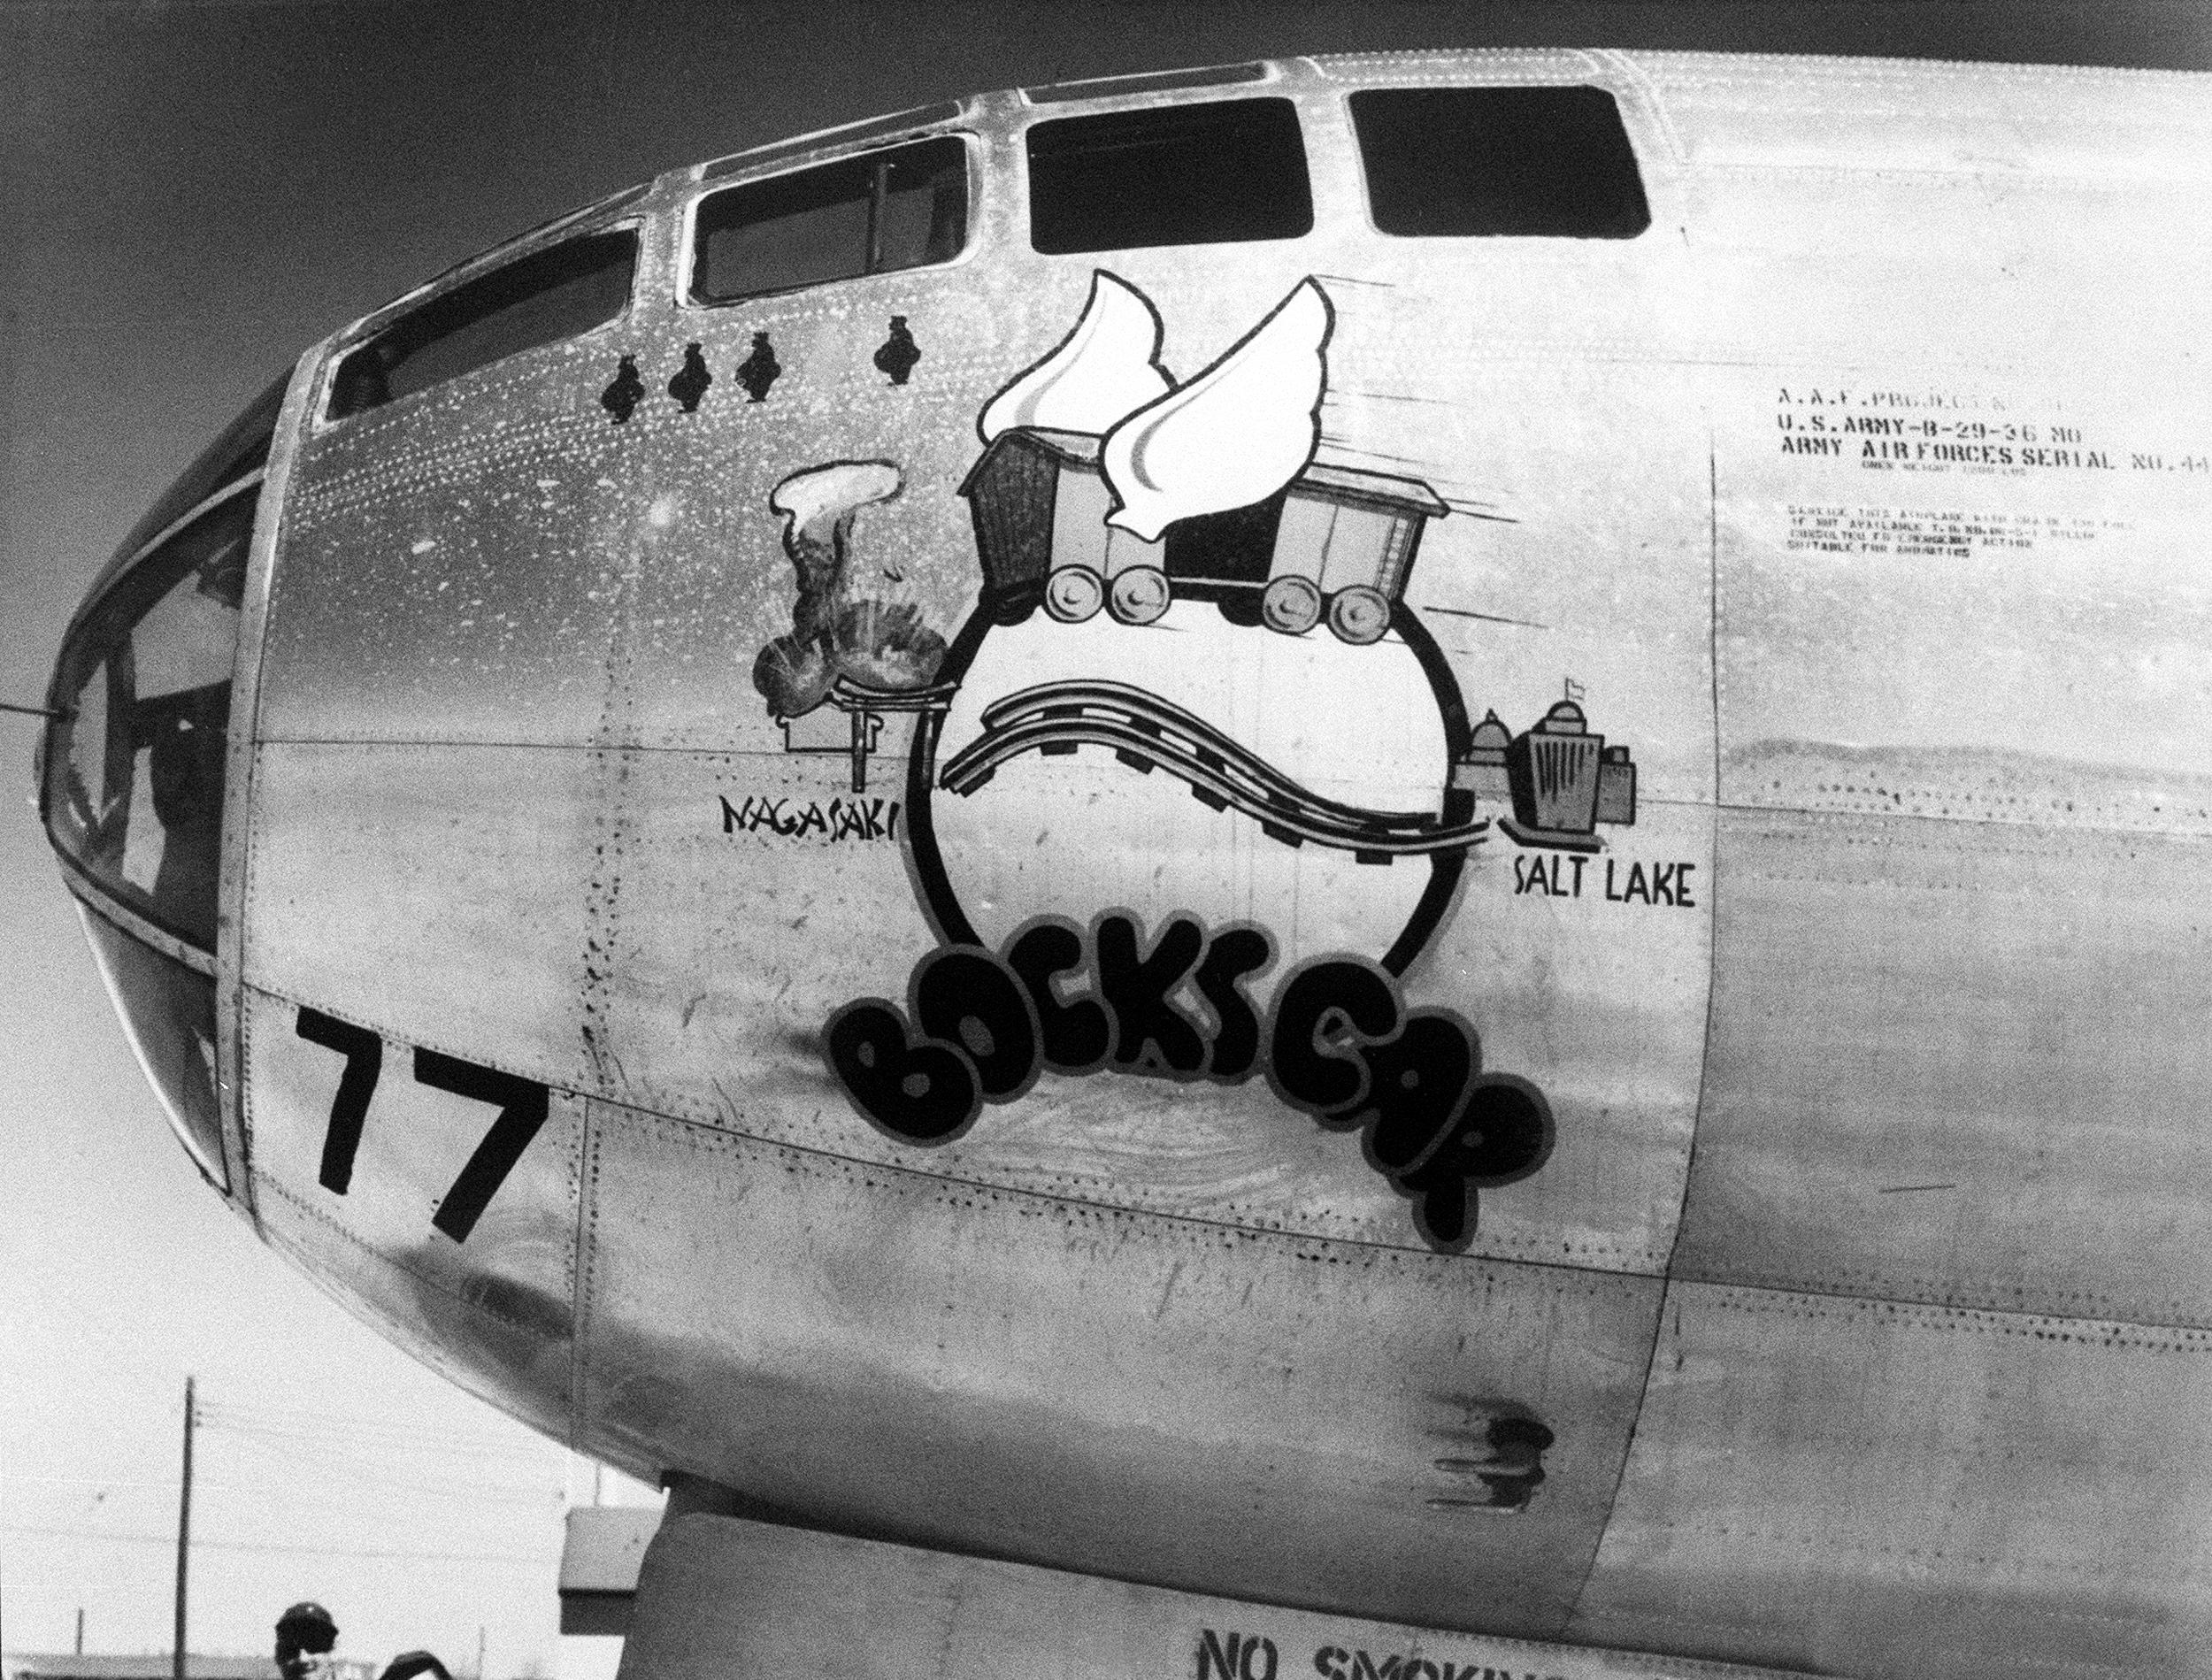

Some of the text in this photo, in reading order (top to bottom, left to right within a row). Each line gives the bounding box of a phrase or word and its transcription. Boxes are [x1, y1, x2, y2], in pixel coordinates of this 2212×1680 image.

[1780, 434, 1843, 456] ARMY
[1861, 439, 1910, 460] AIR
[1916, 441, 2014, 466] FORCES
[2020, 446, 2117, 471] SERIAL
[719, 795, 900, 842] NAGASAKI
[1514, 855, 1696, 908] SALT LAKE
[296, 1005, 550, 1244] 77
[1196, 1628, 1279, 1680] NO
